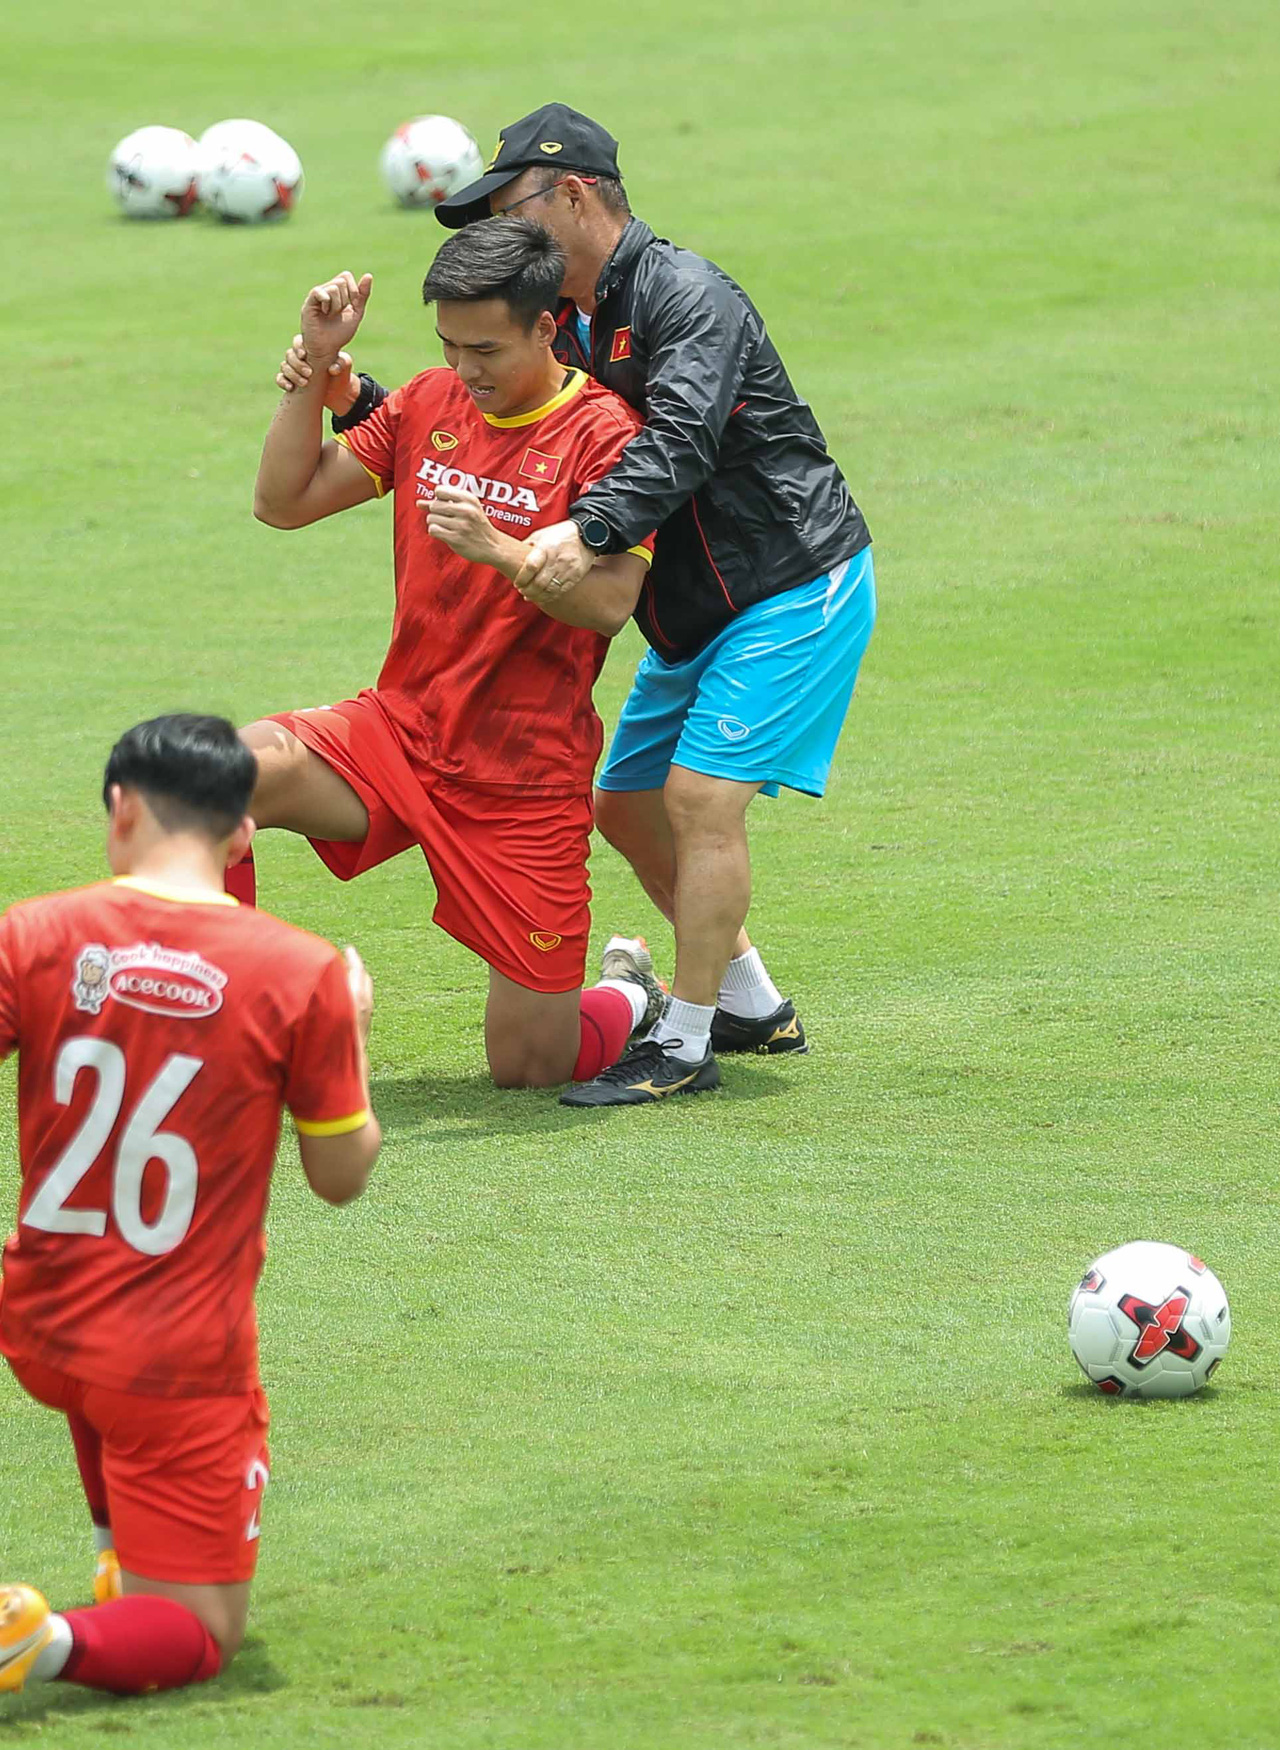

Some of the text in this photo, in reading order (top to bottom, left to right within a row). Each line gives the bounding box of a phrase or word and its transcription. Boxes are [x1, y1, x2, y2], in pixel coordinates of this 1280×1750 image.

[415, 457, 540, 512] HONDA
[415, 483, 434, 500] The
[485, 505, 532, 526] Dreams
[111, 946, 224, 986] Cook happiness
[22, 1035, 204, 1256] 26
